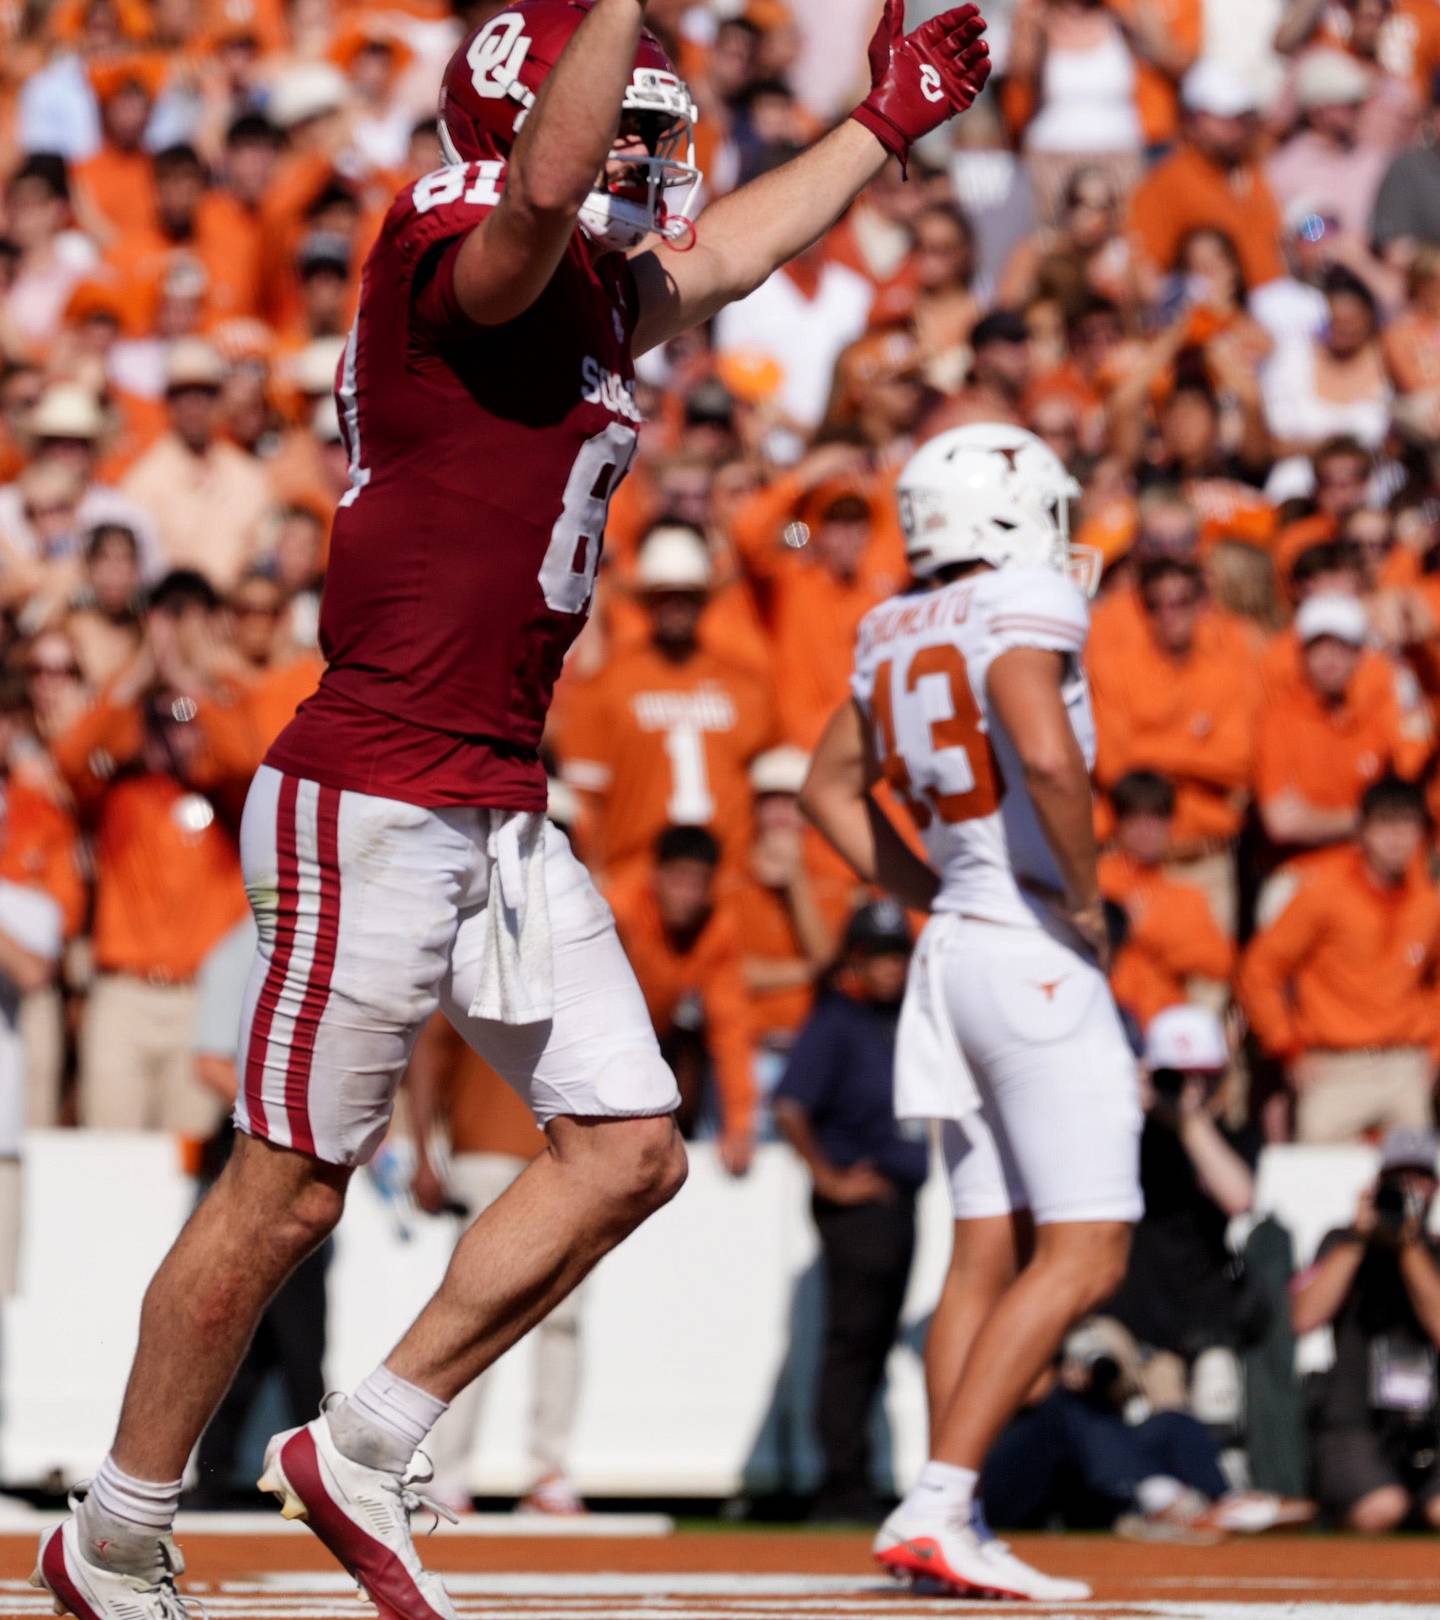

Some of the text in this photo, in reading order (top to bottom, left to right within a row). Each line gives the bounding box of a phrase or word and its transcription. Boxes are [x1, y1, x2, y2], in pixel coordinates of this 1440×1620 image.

[466, 12, 533, 99] OU
[412, 160, 505, 213] 81
[537, 421, 638, 615] 8
